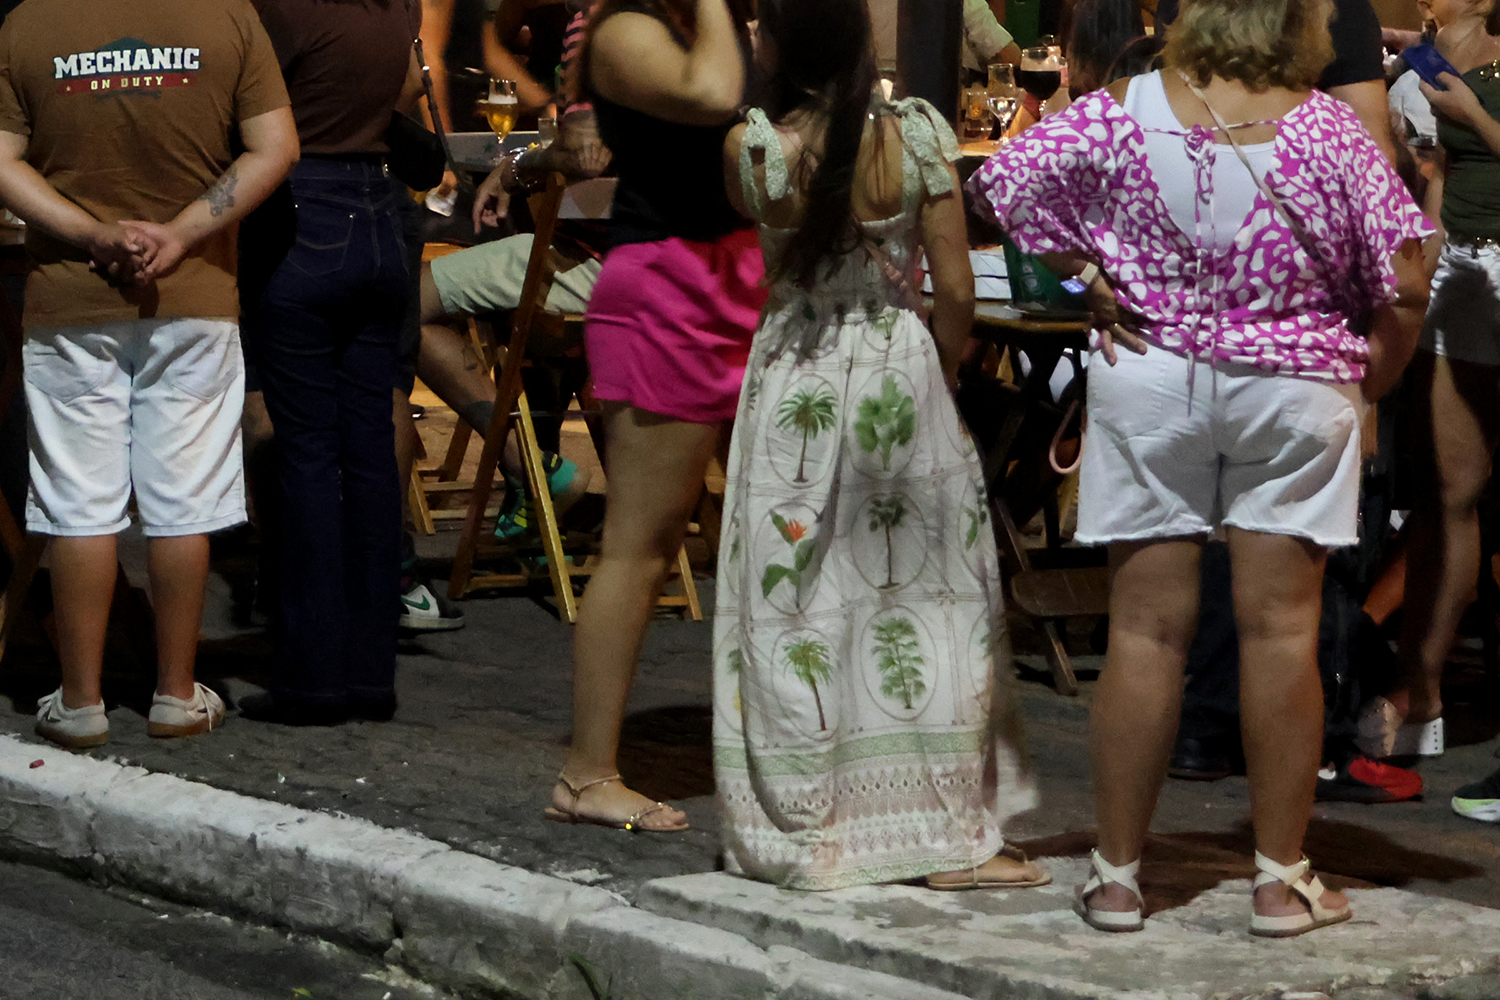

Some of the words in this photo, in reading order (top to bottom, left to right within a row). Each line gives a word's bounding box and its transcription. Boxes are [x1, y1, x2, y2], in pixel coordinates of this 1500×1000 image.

[53, 47, 200, 79] MECHANIC
[90, 78, 111, 90] ON
[120, 76, 164, 88] DUTY
